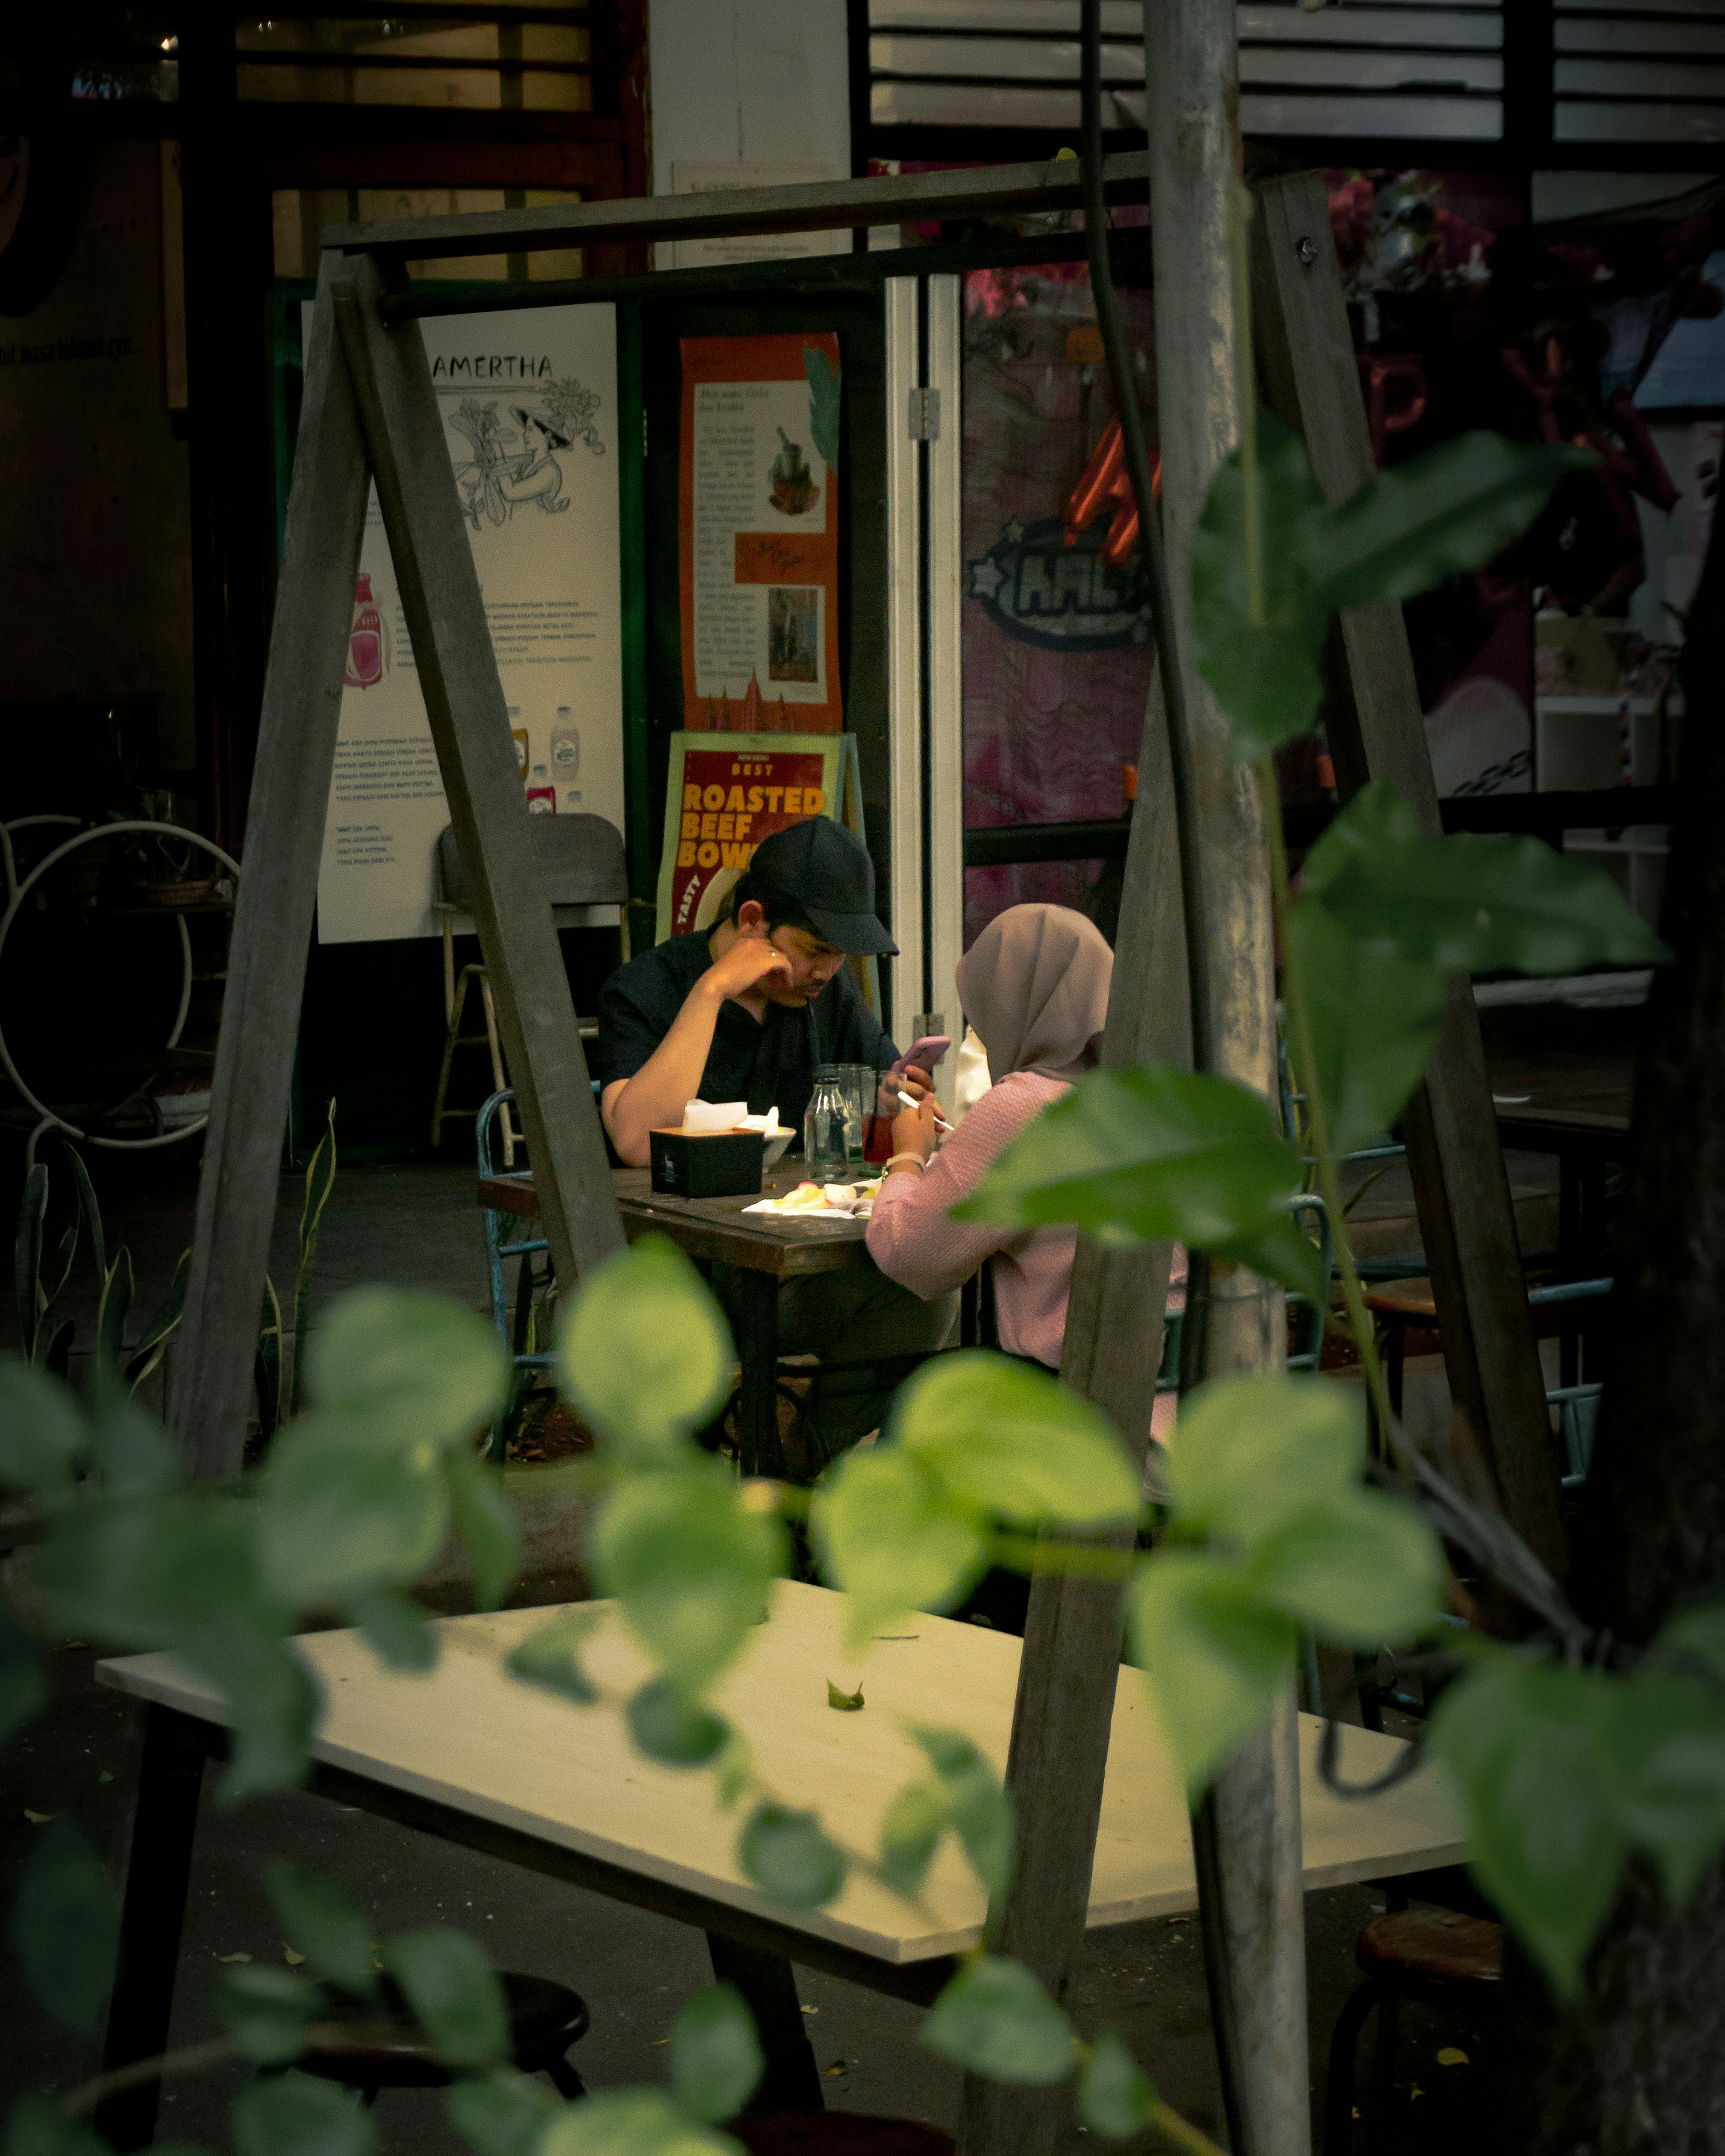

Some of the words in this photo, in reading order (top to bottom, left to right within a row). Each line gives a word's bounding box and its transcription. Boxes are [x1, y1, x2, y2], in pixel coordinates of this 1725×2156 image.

[433, 354, 553, 378] AMERTHA
[732, 763, 773, 776] BEST
[683, 783, 824, 815] ROASTED
[681, 812, 753, 841] BEEF
[677, 840, 760, 870] BOW
[677, 873, 701, 924] TASTY
